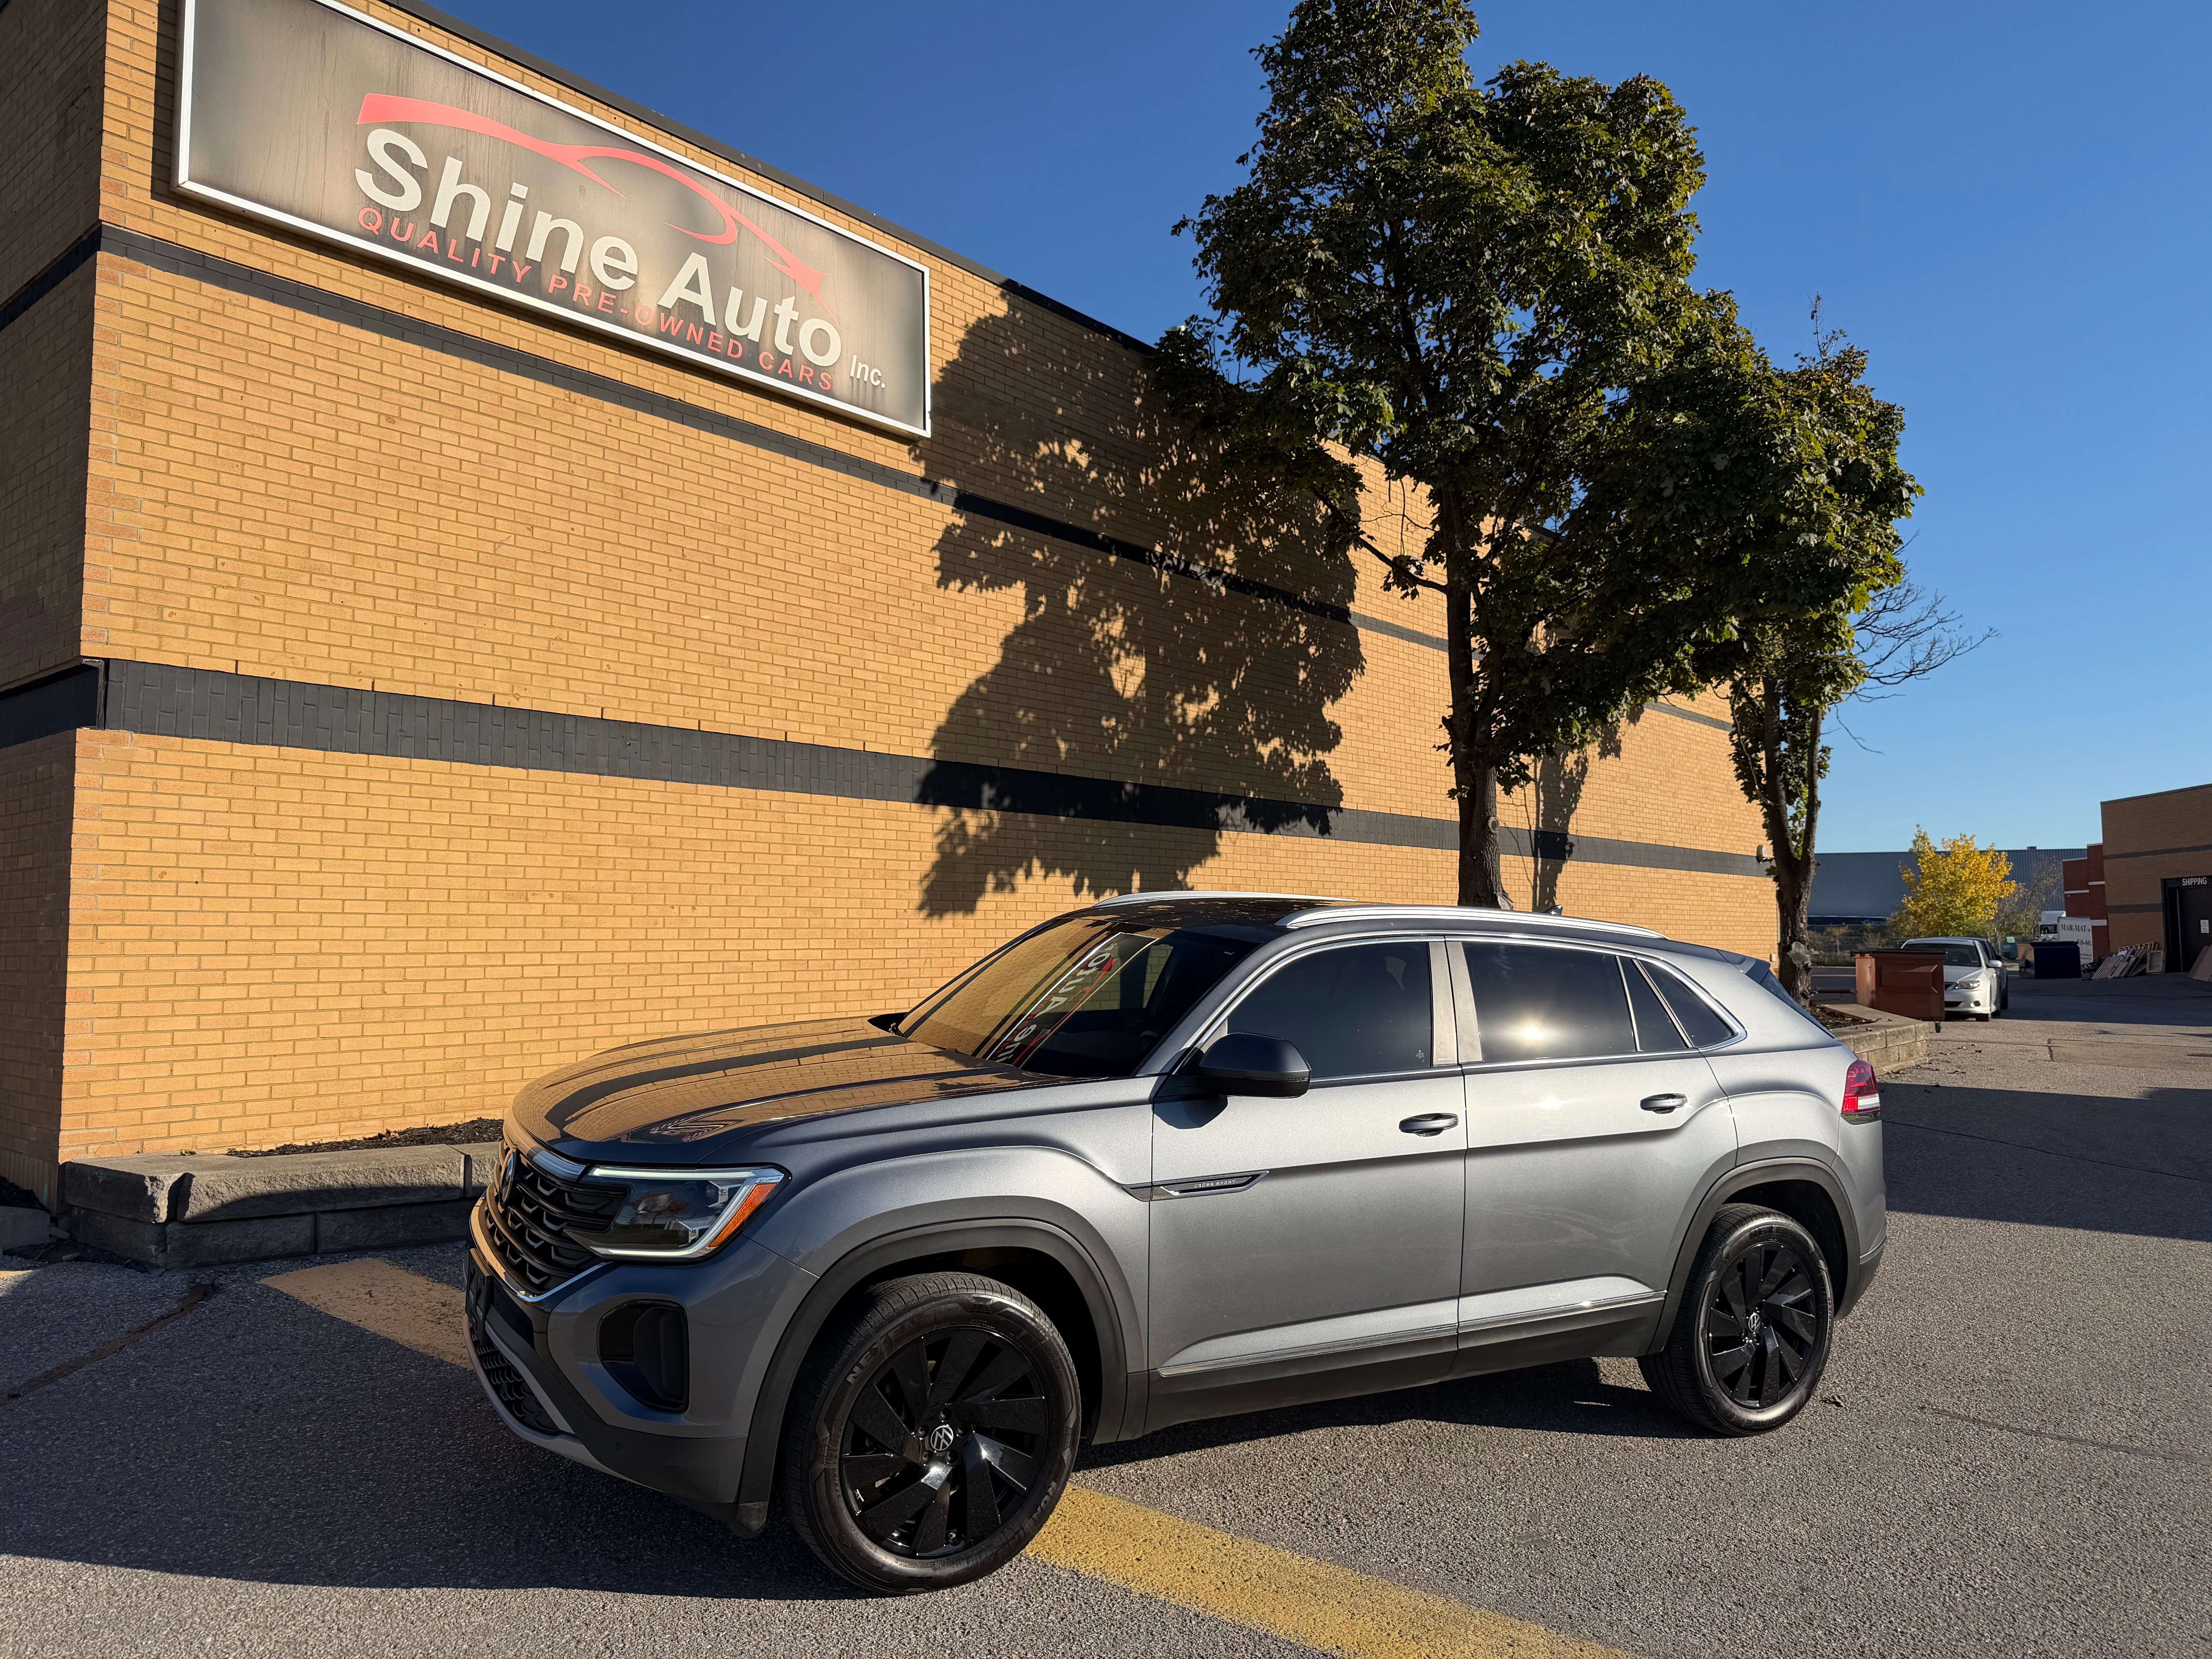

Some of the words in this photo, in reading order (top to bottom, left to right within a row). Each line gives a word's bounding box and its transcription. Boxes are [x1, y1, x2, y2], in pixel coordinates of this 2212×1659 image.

[355, 129, 638, 290] Shine
[658, 252, 842, 366] Auto
[850, 354, 886, 388] Inc.
[358, 207, 532, 283] QUALITY
[549, 275, 744, 359] PRE-OWNED
[759, 351, 833, 391] CARS
[2061, 924, 2087, 932] MAR-MAT
[2182, 877, 2207, 886] SHIPPING
